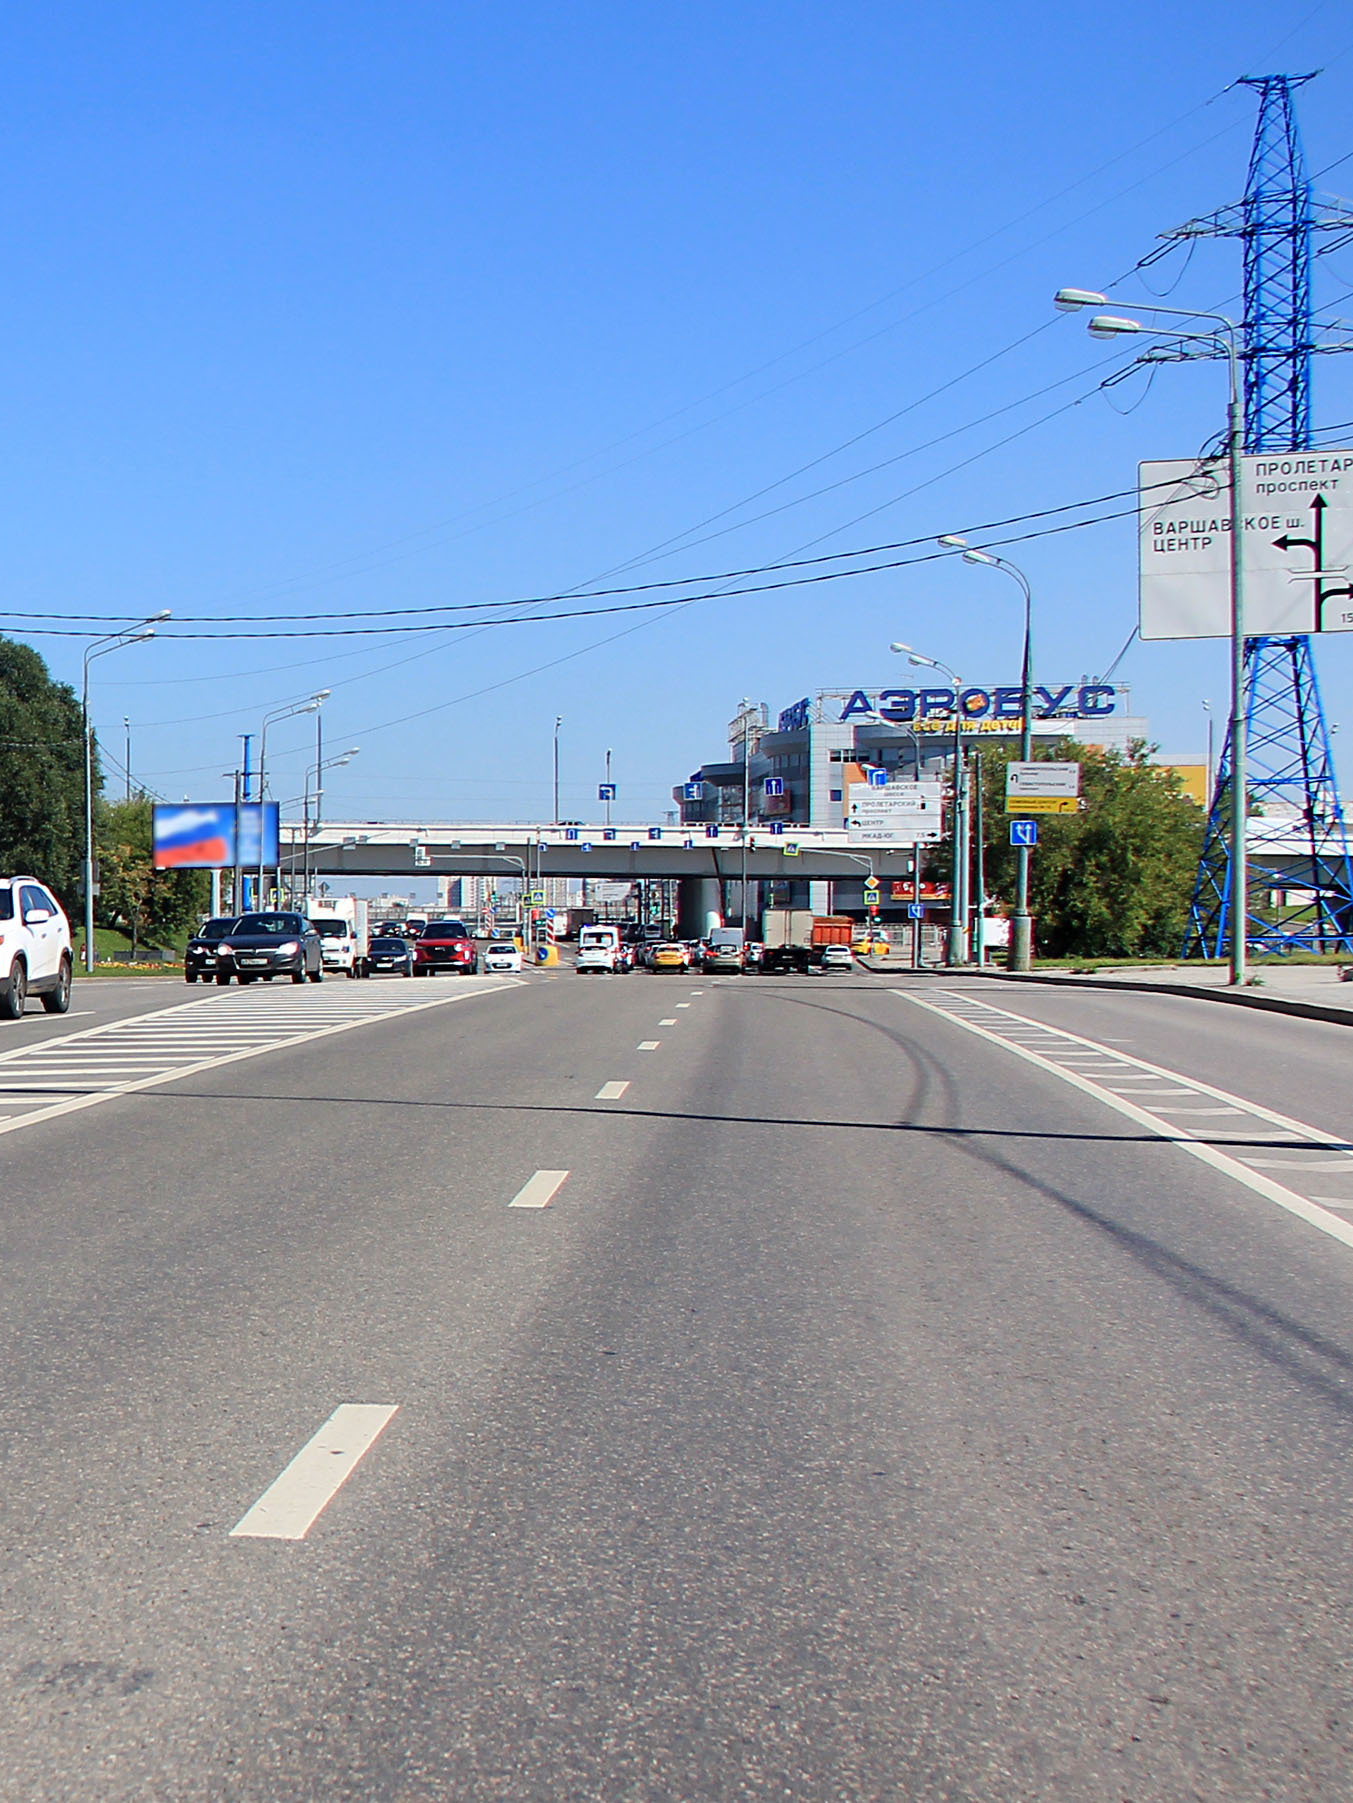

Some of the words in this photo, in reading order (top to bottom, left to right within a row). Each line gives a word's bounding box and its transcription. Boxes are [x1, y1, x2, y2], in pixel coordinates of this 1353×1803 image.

[1256, 479, 1339, 496] проспект
[1153, 516, 1281, 535] ВАРШАВКОЕ
[1286, 518, 1305, 529] ш.
[1153, 537, 1212, 553] ЦЕНТР
[839, 685, 1116, 721] АЭРОБУС
